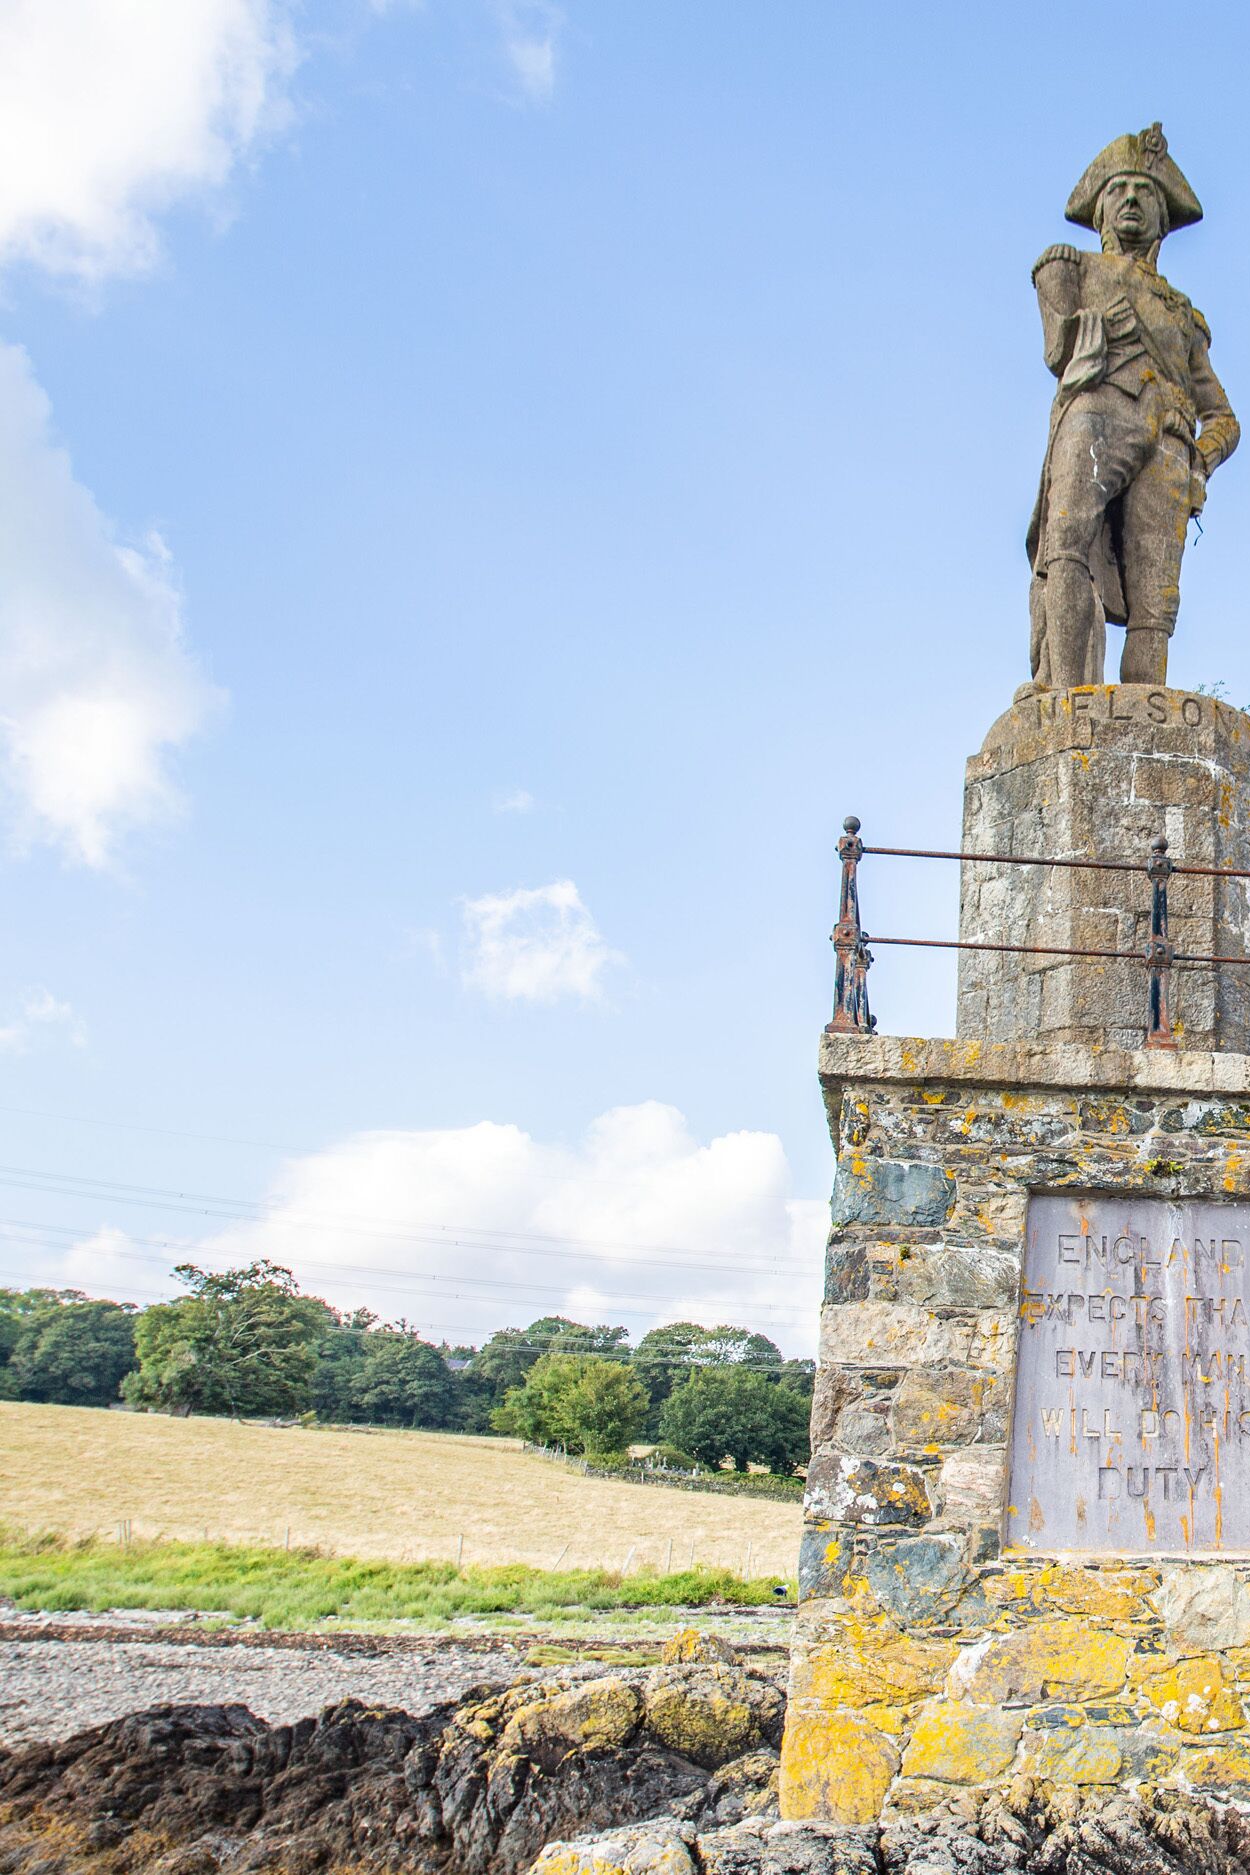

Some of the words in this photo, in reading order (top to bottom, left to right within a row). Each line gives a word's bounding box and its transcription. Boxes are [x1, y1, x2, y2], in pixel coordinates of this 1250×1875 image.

[1058, 1234, 1244, 1269] ENGLAND
[1026, 1293, 1168, 1323] EXPECTS
[1056, 1350, 1164, 1382] EVERY
[1181, 1352, 1246, 1384] MAN
[1041, 1407, 1122, 1438] WILL
[1141, 1408, 1181, 1438] DO
[1099, 1466, 1205, 1500] DUTY
